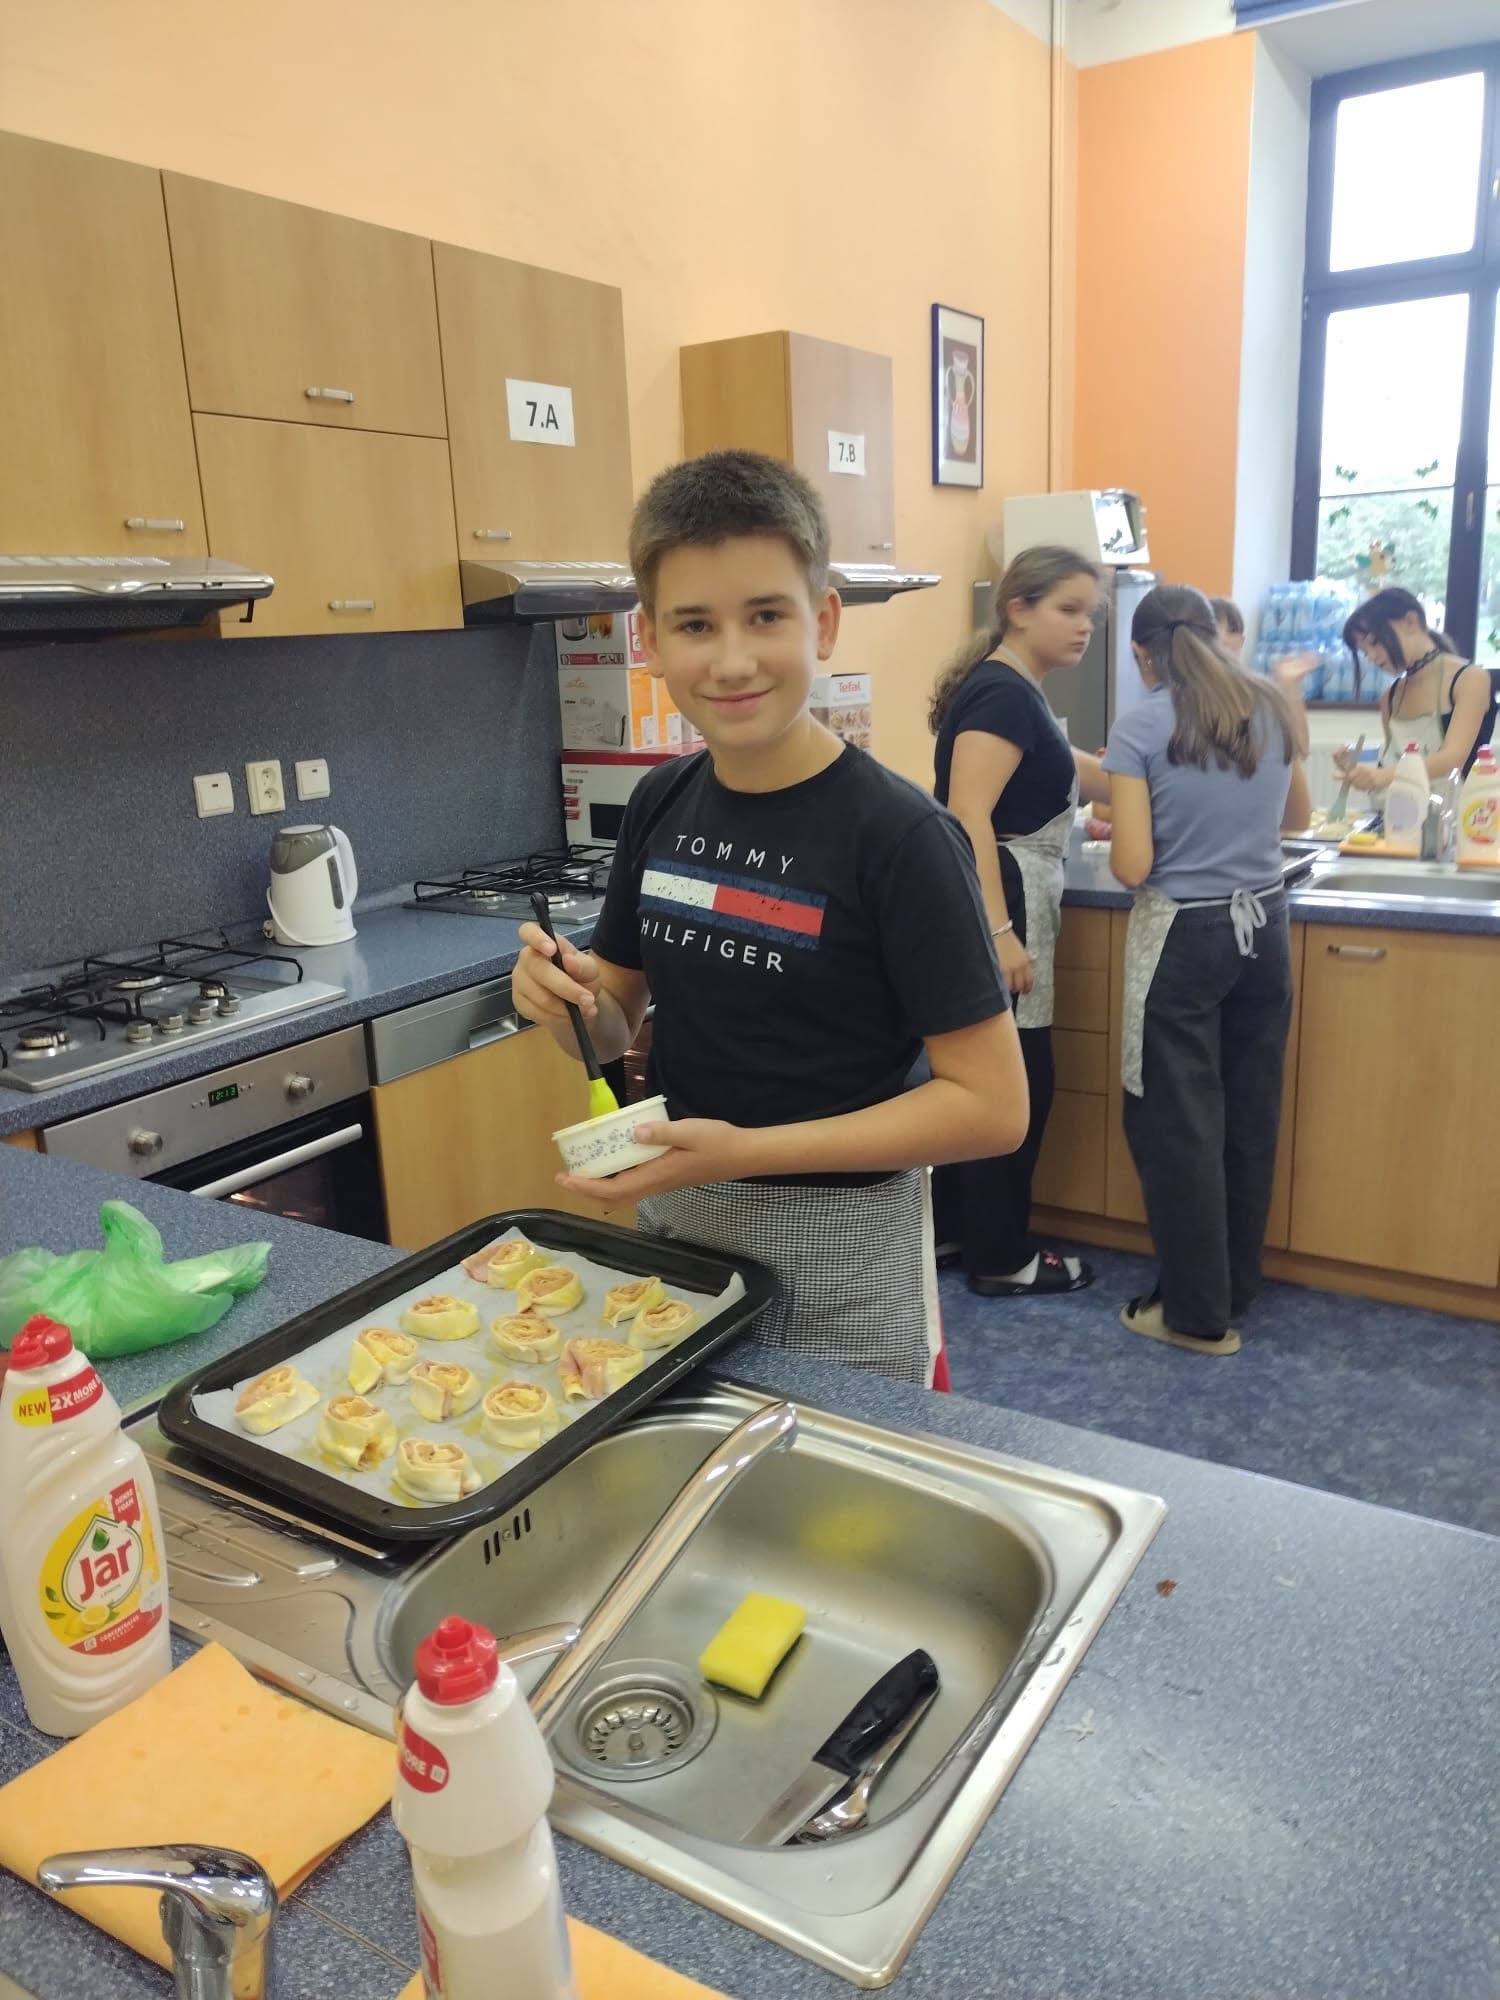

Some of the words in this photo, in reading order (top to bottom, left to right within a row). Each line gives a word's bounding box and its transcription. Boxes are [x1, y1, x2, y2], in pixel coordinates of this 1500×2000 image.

[525, 400, 559, 430] 7.A
[838, 442, 857, 463] 7.B
[836, 681, 862, 693] Tefal
[675, 835, 793, 874] TOMMY
[640, 917, 784, 972] HILFIGER
[18, 1402, 47, 1417] NEW
[51, 1392, 75, 1411] 2X
[79, 1539, 132, 1603] Jar
